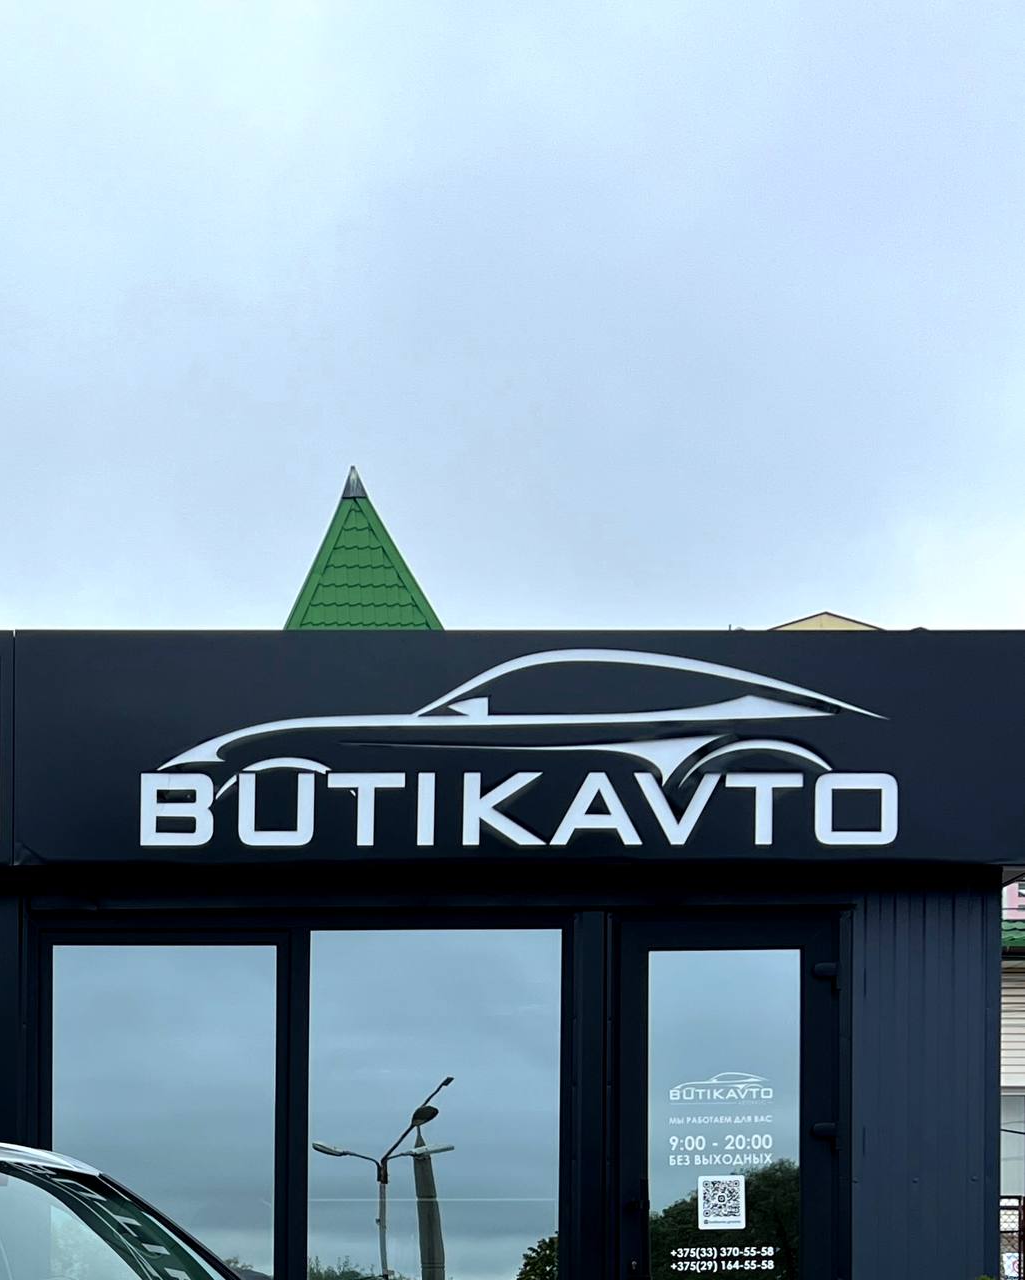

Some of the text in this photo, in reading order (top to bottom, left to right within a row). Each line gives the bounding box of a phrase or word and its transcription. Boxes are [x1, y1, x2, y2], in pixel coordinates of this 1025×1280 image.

[139, 771, 899, 847] BUTIKAVTO
[669, 1087, 774, 1100] BUTIKAVTO
[686, 1115, 732, 1124] РАБОТАЕМ
[669, 1135, 706, 1151] 9:00
[724, 1134, 773, 1150] 20:00
[669, 1153, 773, 1166] БЕЗ ВЫХОДНЫХ
[670, 1246, 775, 1259] +375(33) 370-55-58
[670, 1259, 775, 1273] +375(29) 164-55-58
